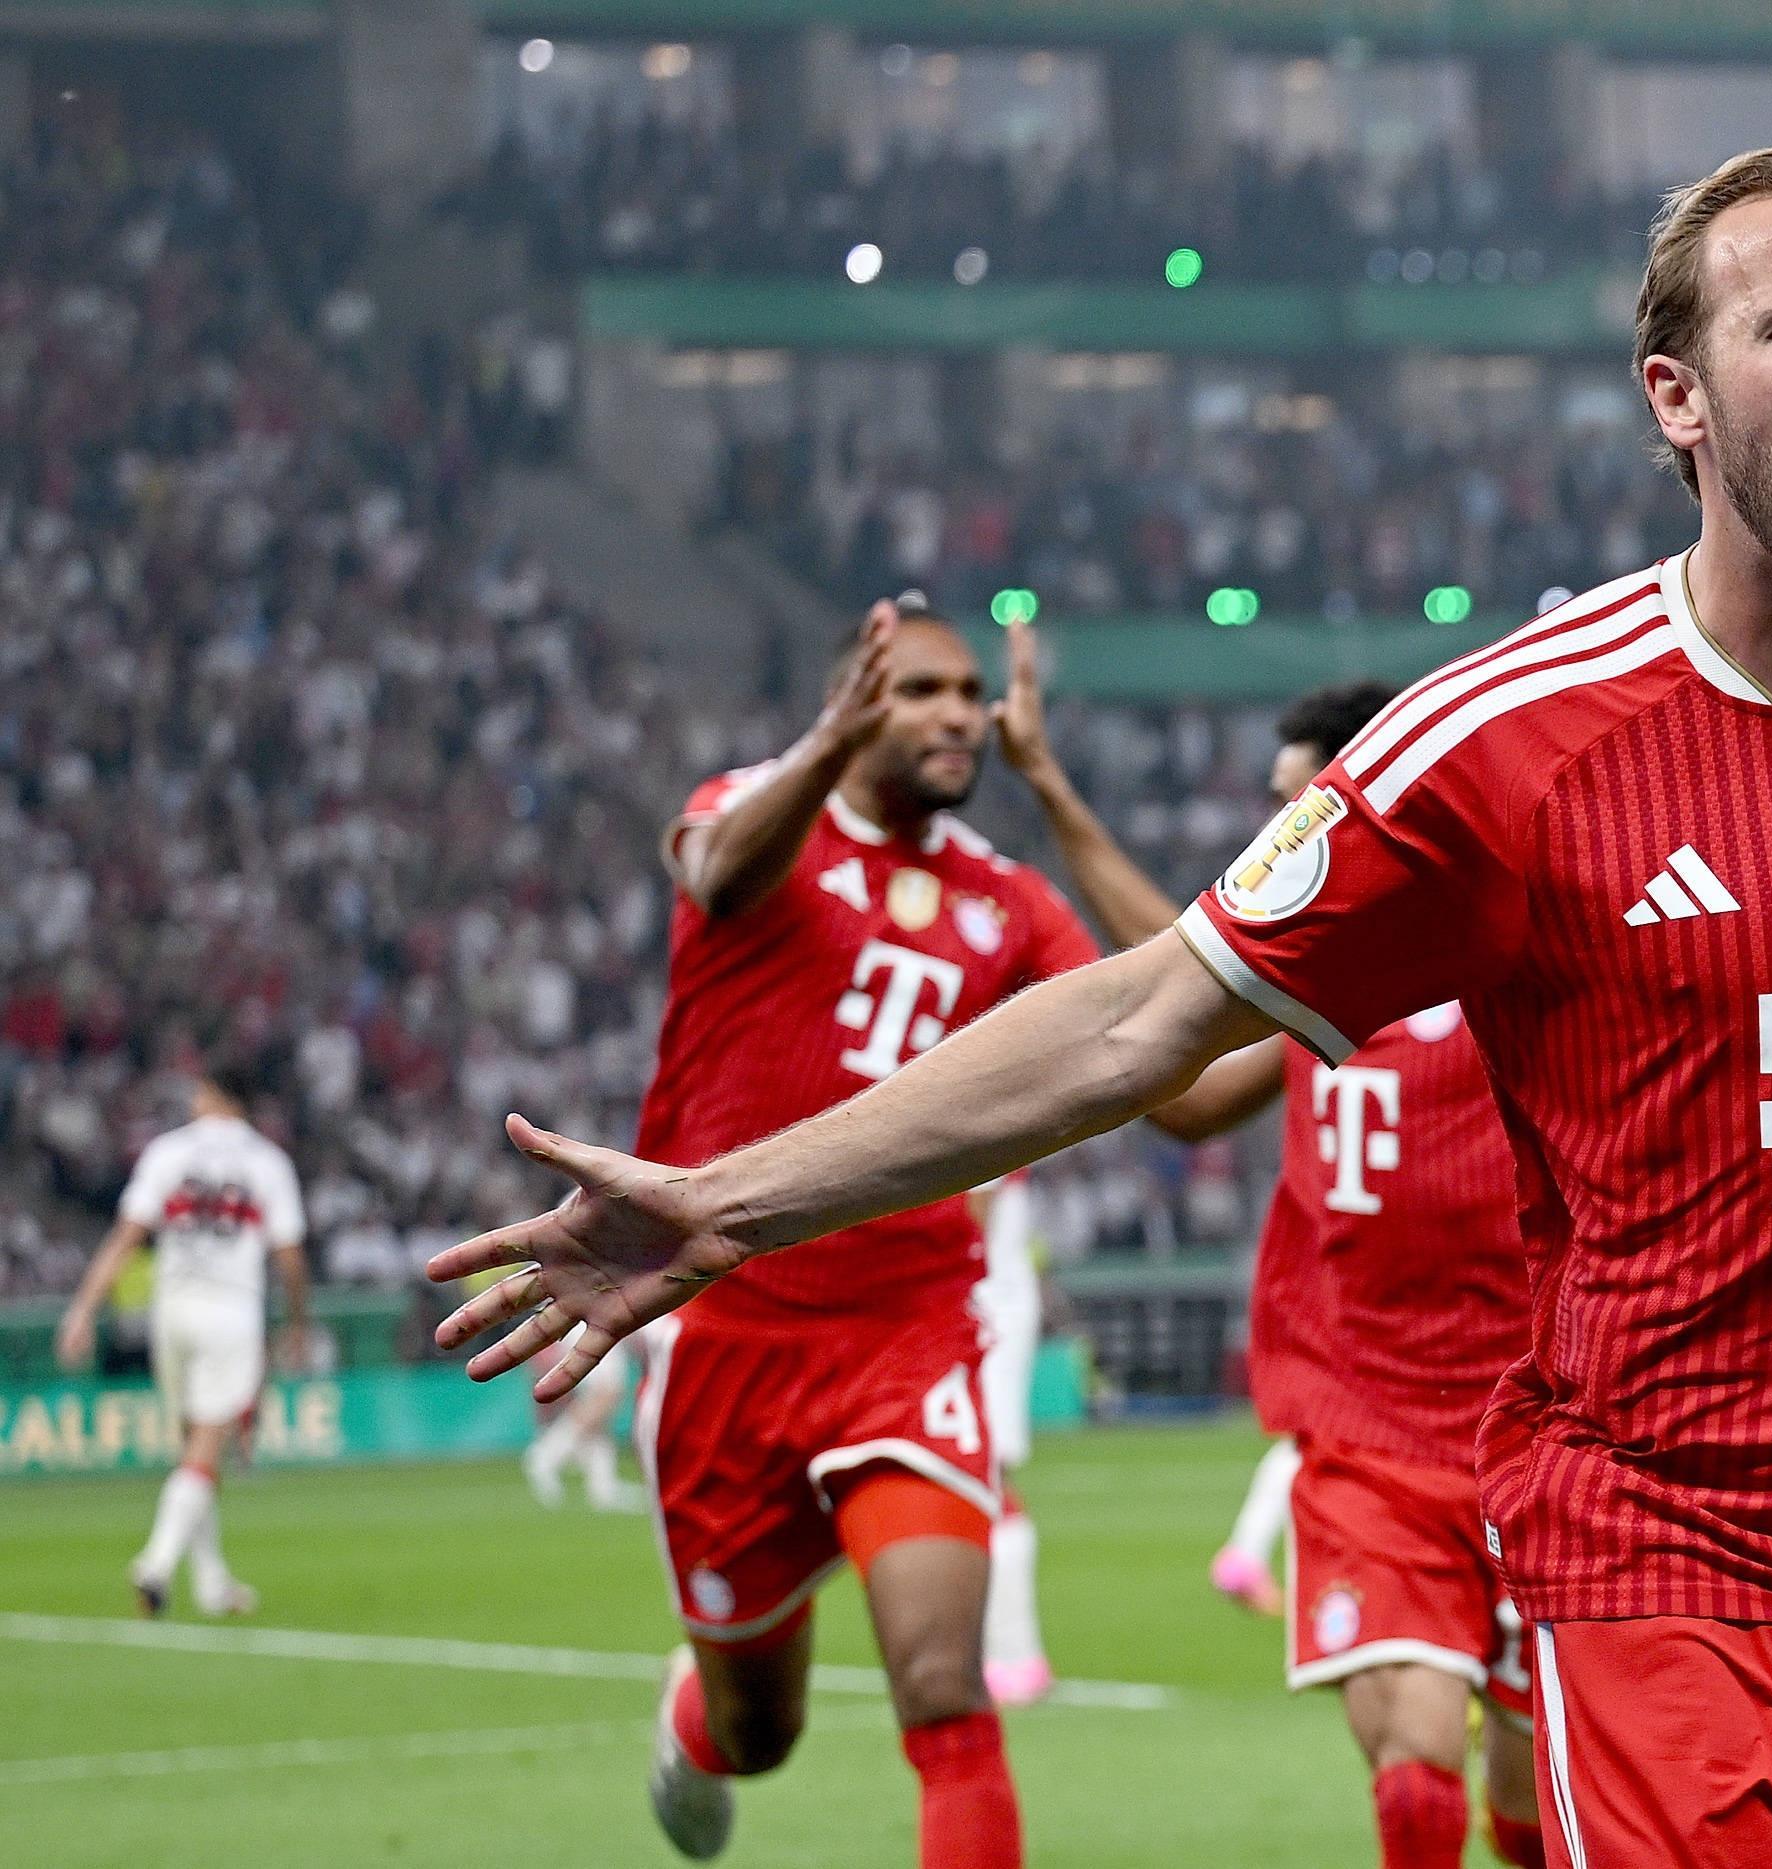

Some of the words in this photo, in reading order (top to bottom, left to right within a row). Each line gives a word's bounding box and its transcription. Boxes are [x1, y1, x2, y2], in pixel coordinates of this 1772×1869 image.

[834, 938, 964, 1081] T
[1312, 1062, 1400, 1215] T
[922, 1361, 981, 1455] 4
